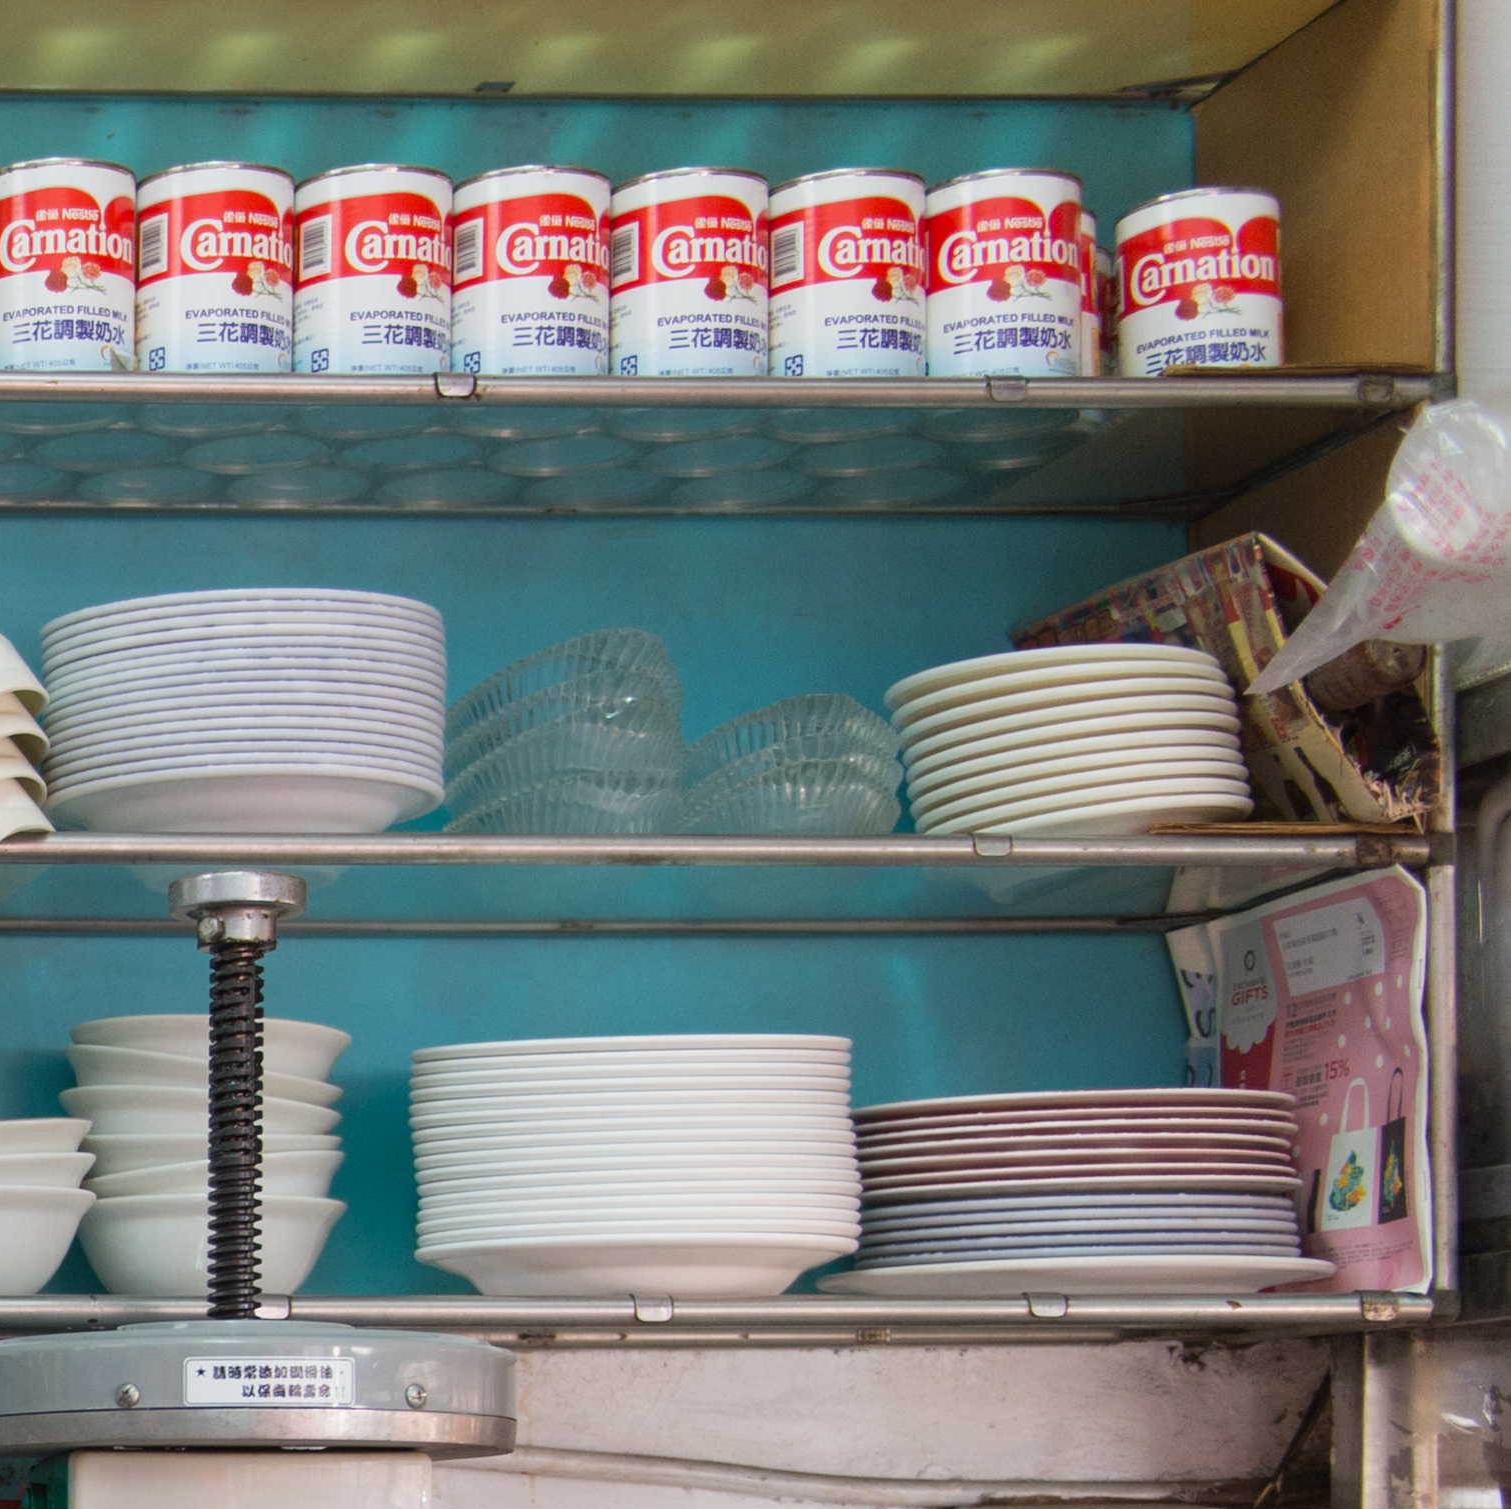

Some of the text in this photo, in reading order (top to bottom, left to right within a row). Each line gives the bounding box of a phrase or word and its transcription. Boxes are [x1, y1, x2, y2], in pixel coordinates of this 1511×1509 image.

[938, 231, 1078, 284] Carnation
[1130, 249, 1275, 305] Carnation
[3, 306, 74, 321] EVAPORATED
[185, 308, 259, 320] EVAPORATED
[350, 310, 423, 322] EVAPORATED
[501, 312, 575, 323] EVAPORATED
[657, 314, 732, 326] EVAPORATED
[824, 315, 899, 327] EVAPORATED
[943, 313, 1018, 334] EVAPORATED
[12, 319, 125, 345] 三花調製奶水
[953, 327, 1072, 355] 三花調製奶水
[1136, 330, 1207, 354] EVAPORATED
[1231, 985, 1269, 1005] GIFTS
[1325, 1059, 1350, 1080] 15%
